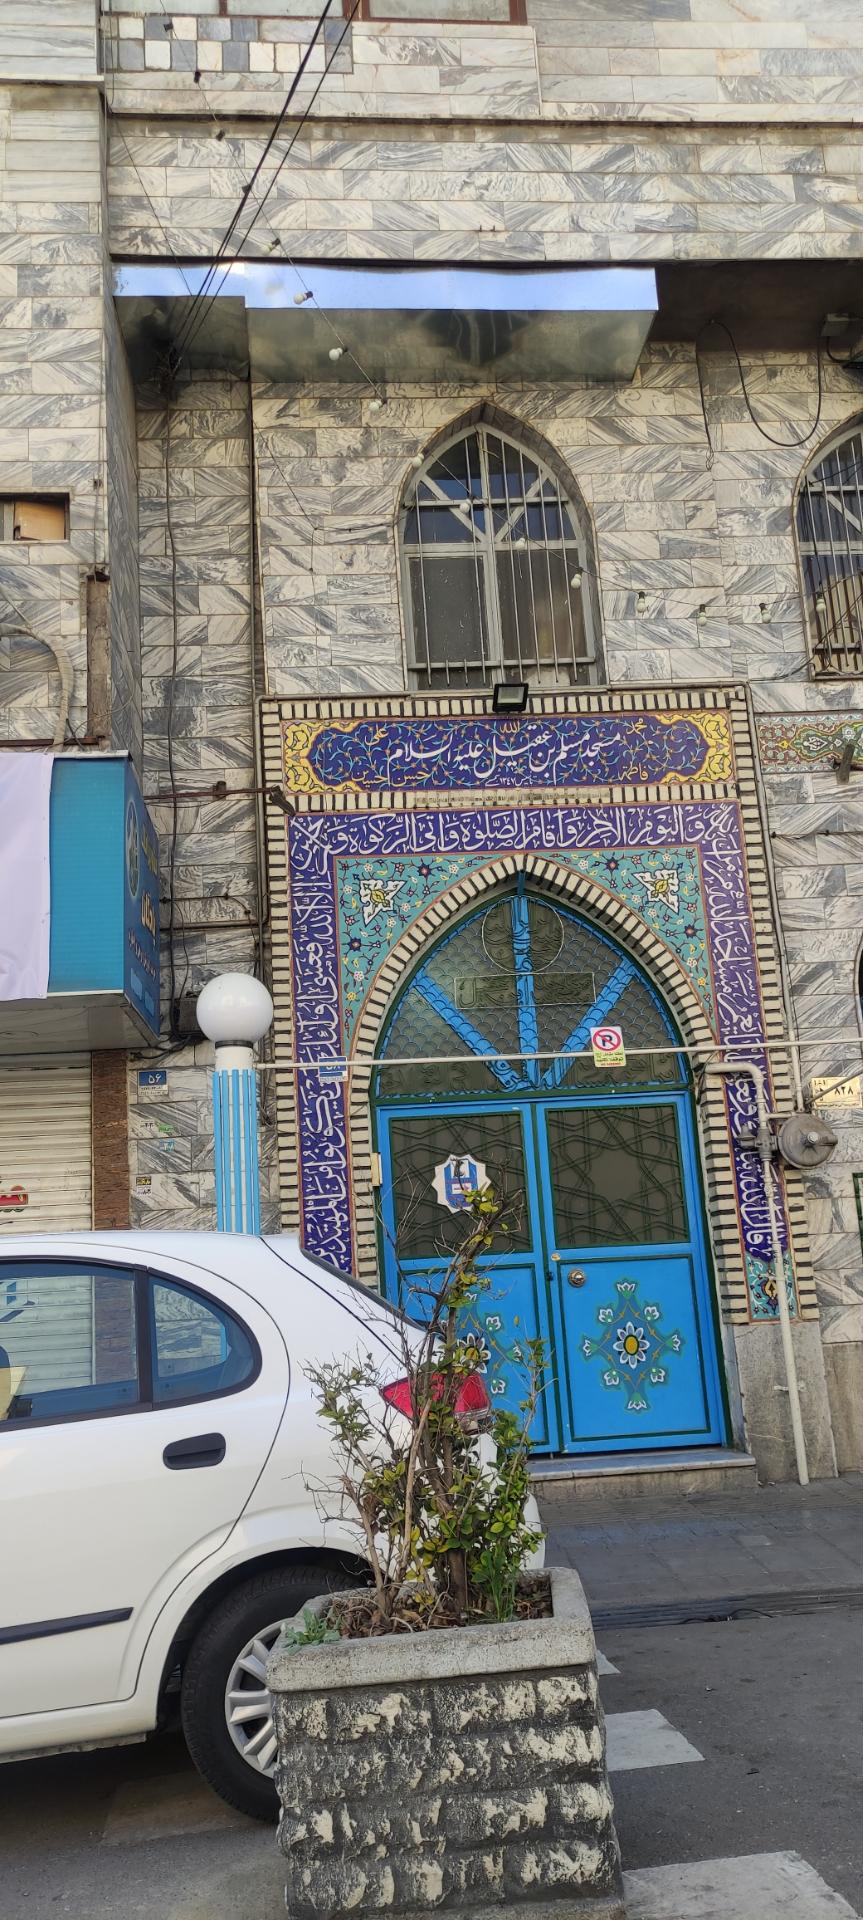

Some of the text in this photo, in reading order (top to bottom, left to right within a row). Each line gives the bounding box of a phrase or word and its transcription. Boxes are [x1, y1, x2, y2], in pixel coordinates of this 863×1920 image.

[500, 721, 521, 734] الله
[387, 724, 621, 787] مسجد مسلم بن عقیل علیه السلام
[391, 770, 432, 787] حسن
